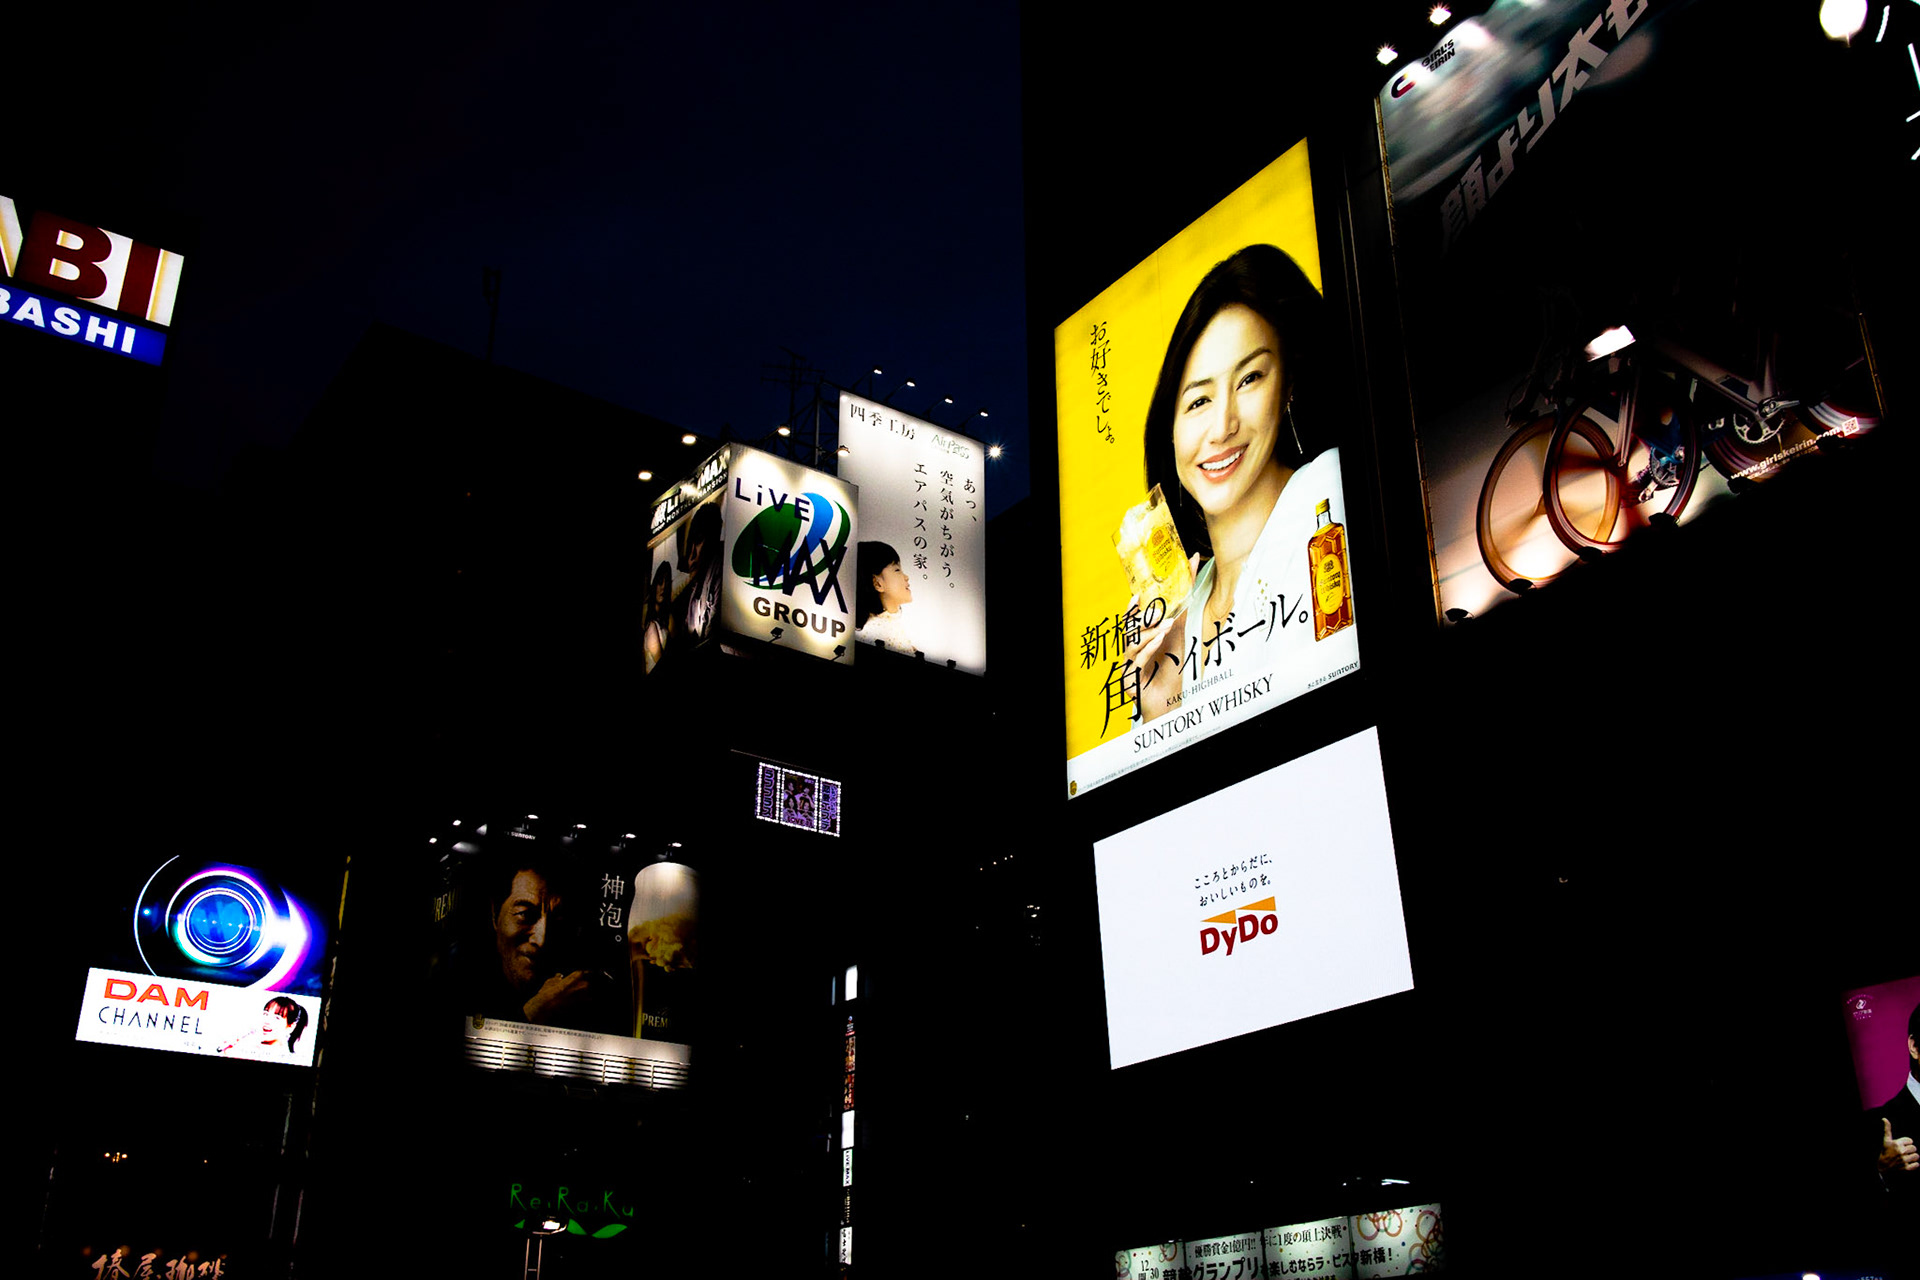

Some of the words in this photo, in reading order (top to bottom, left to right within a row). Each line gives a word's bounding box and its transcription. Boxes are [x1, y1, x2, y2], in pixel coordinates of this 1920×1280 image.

[1421, 39, 1454, 67] GIRL'S
[1427, 48, 1455, 72] EIRIN
[1090, 321, 1115, 444] お好きでしょ。
[914, 463, 928, 580] エアパスの家。
[963, 478, 978, 522] あっ、
[940, 470, 955, 589] 空気がちがう。
[753, 525, 849, 614] MAX
[753, 596, 846, 639] GROUP
[1079, 597, 1167, 670] 新橋の
[1099, 593, 1309, 739] 角ハイボール。
[1327, 660, 1359, 680] SUNTORY
[1166, 669, 1234, 707] KAKU-HIGHBALL
[1133, 705, 1204, 753] SUNTORY
[1208, 673, 1274, 717] WHISKY
[1195, 853, 1272, 889] こころとからだに、
[1199, 873, 1271, 907] おいしいものを。
[600, 873, 624, 943] 神泡。
[1199, 913, 1279, 956] DyDo
[104, 978, 209, 1011] DAM
[98, 1006, 203, 1035] CHANNEL
